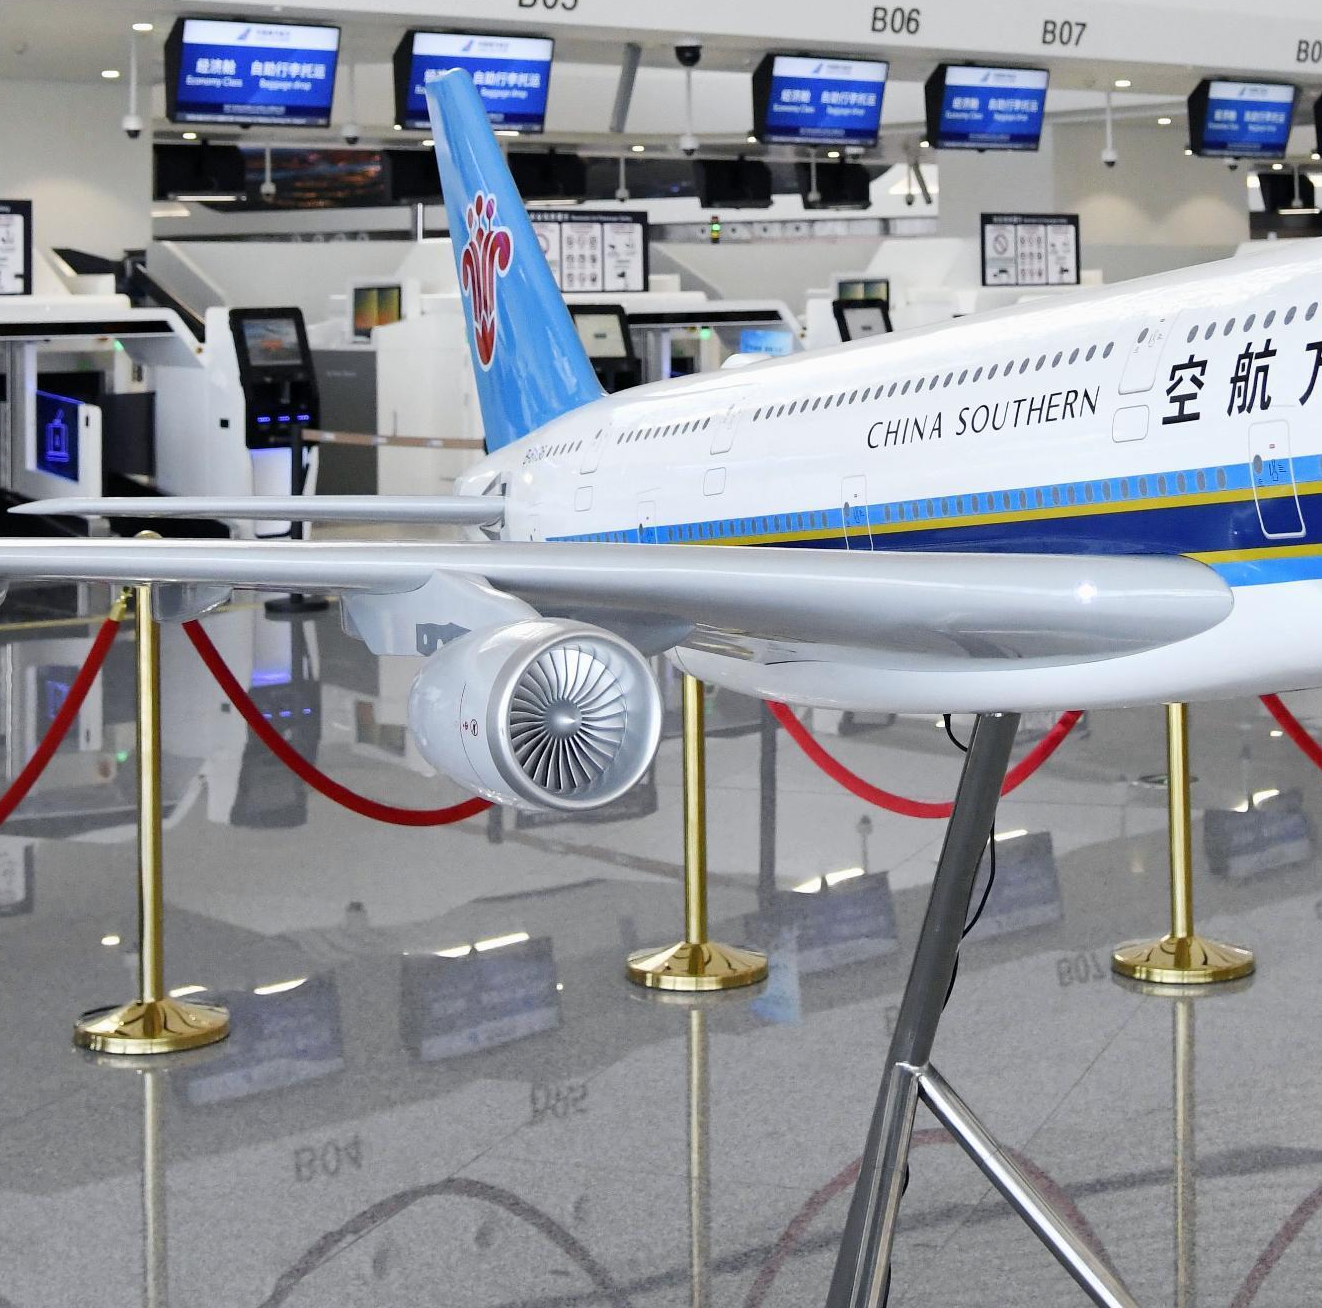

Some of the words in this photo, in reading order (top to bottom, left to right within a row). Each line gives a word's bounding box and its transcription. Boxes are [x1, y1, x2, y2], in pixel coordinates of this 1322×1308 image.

[871, 6, 921, 34] B06
[1042, 20, 1087, 47] B07
[867, 412, 942, 449] CHINA
[955, 385, 1100, 436] SOUTHERN
